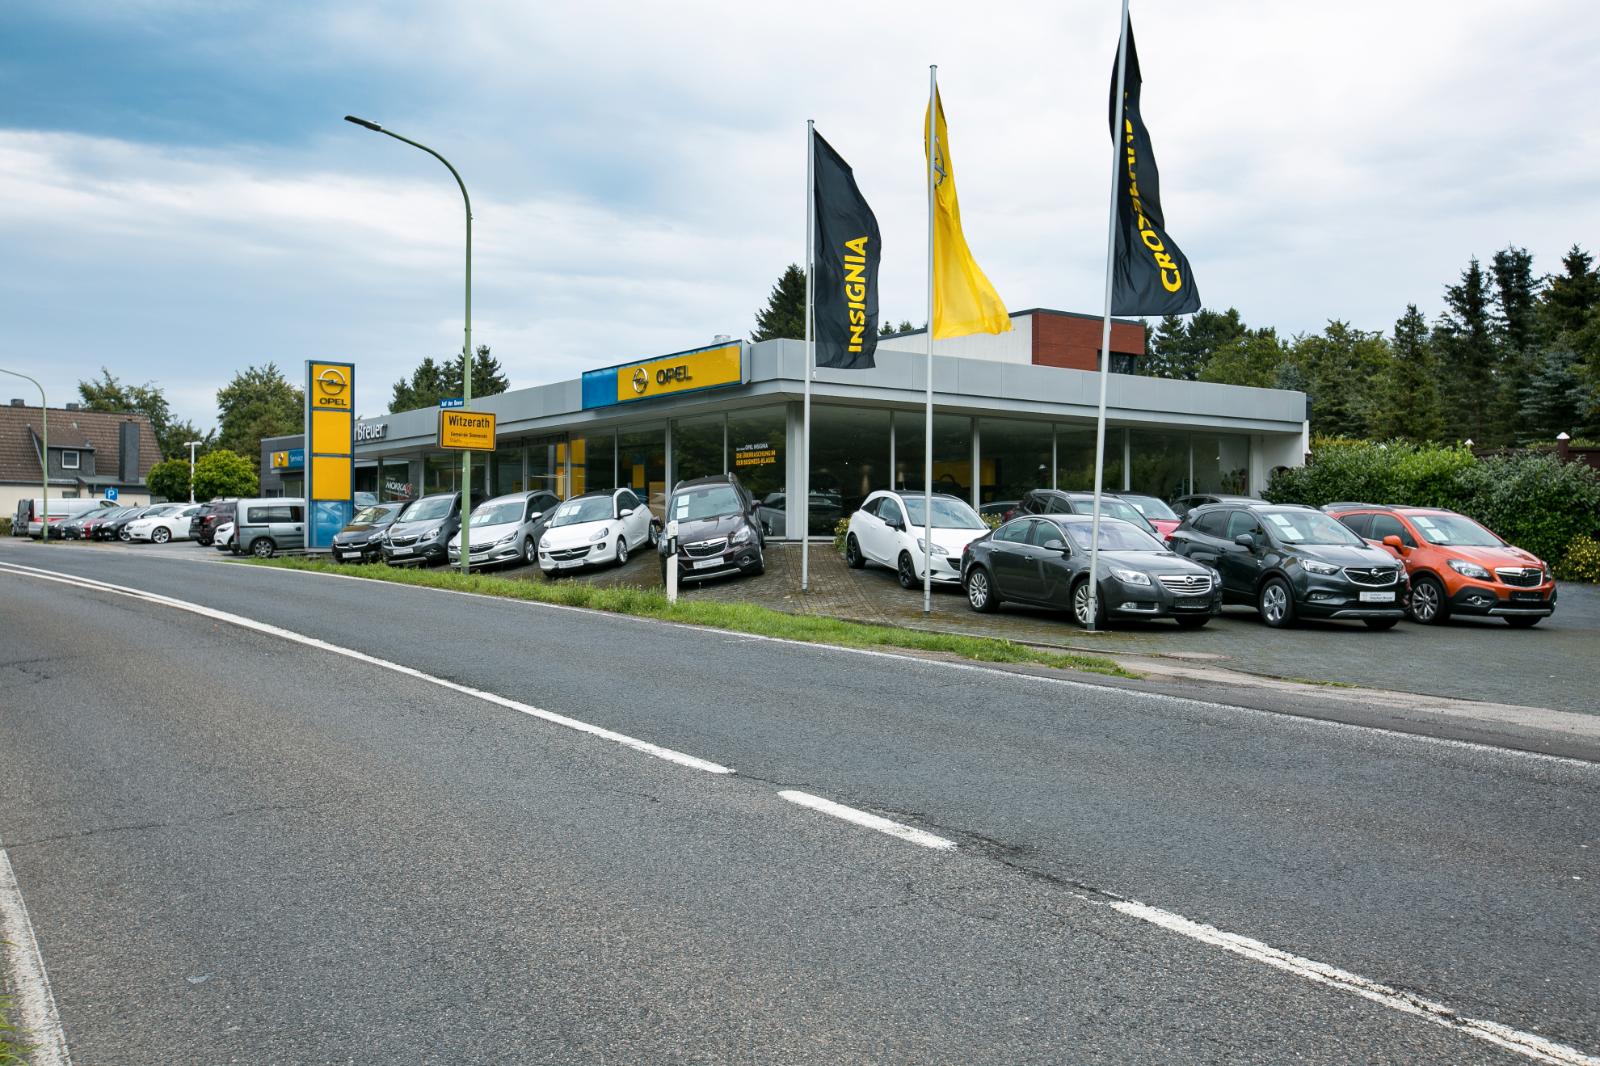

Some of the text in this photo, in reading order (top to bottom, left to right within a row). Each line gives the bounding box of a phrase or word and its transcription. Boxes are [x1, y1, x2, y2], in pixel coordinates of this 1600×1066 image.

[844, 236, 868, 353] INSIGNIA
[656, 365, 692, 385] OPEL
[319, 397, 347, 406] OPEL
[448, 415, 490, 428] Witzerath
[357, 422, 386, 440] Breuer
[107, 489, 114, 499] P
